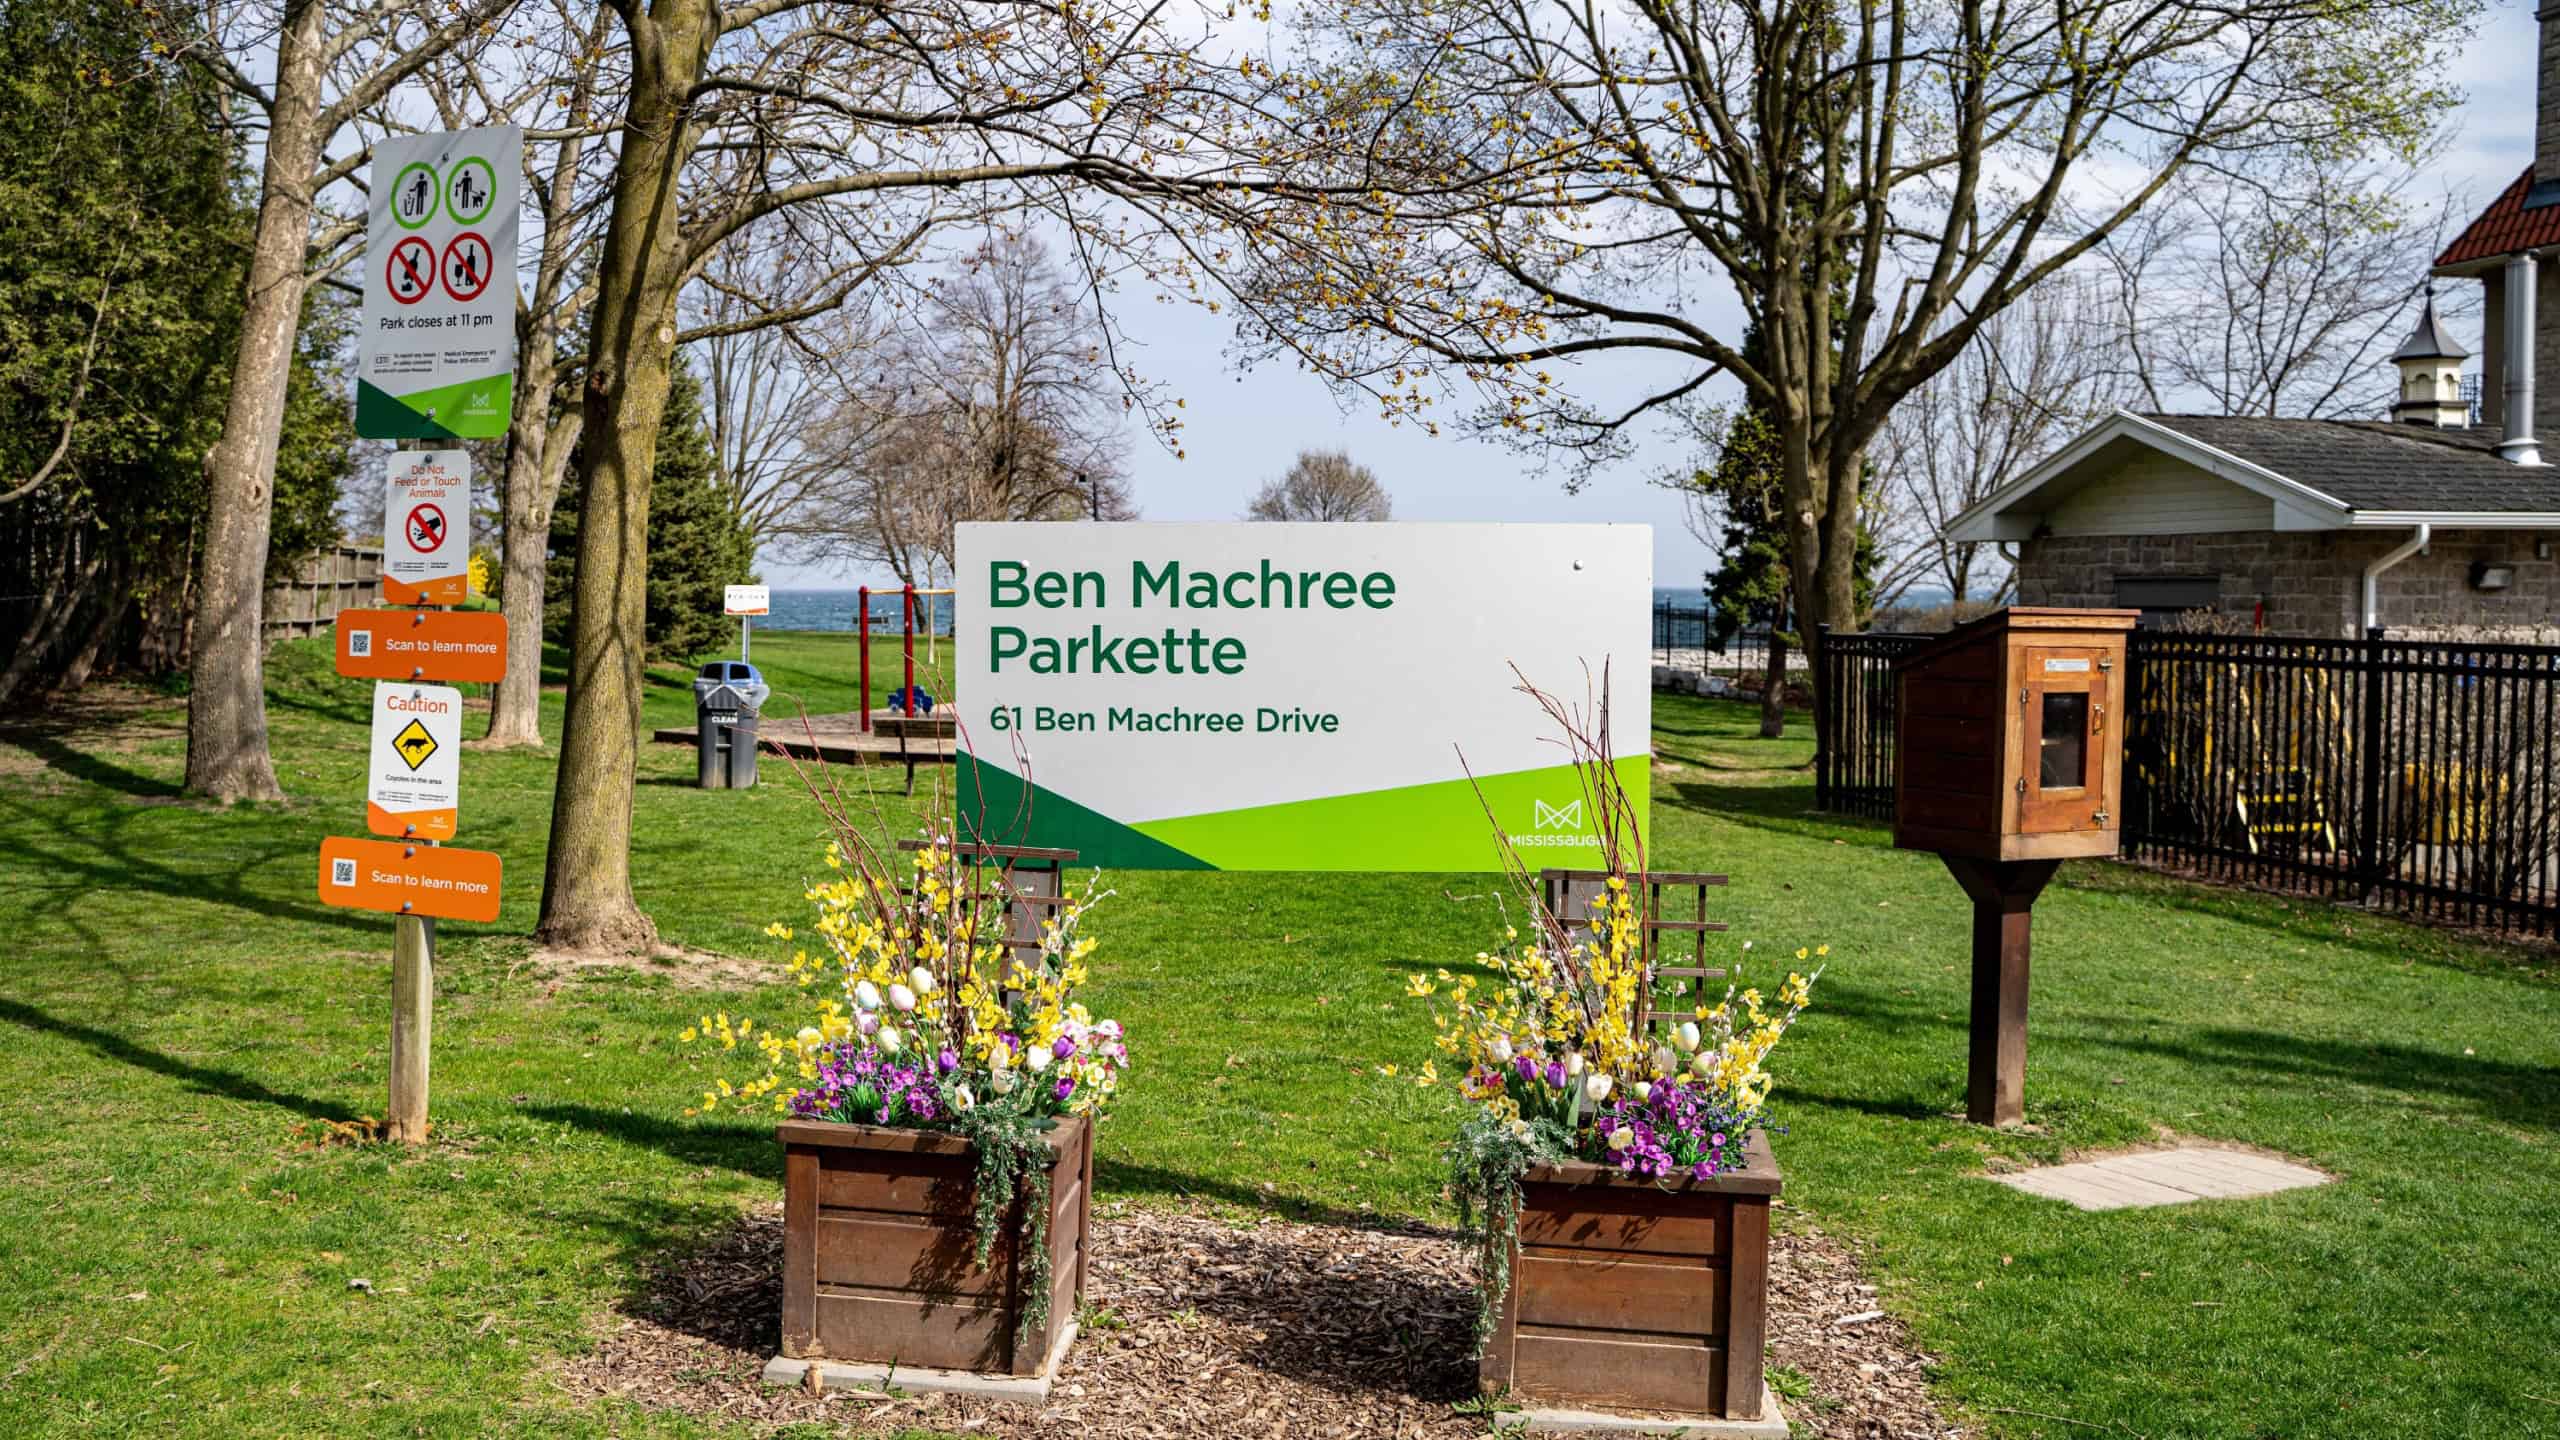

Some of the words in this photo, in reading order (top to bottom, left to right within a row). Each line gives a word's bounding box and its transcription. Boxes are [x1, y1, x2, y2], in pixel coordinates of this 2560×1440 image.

[380, 317, 405, 330] Park
[407, 315, 442, 328] closes
[446, 314, 457, 327] at
[461, 313, 470, 326] 11
[473, 314, 493, 328] pm
[411, 465, 425, 475] Do
[427, 464, 445, 475] Not
[394, 476, 418, 487] Feed
[420, 478, 430, 486] or
[434, 476, 461, 487] Touch
[408, 487, 446, 498] Animals
[991, 560, 1105, 609] Ben
[1133, 560, 1397, 609] Machree
[386, 639, 415, 651] Scan
[417, 640, 430, 652] to
[433, 640, 463, 653] learn
[465, 643, 497, 654] more
[991, 625, 1247, 675] Parkette
[386, 695, 449, 714] Caution
[712, 716, 737, 724] CLEAN
[991, 706, 1022, 732] 61
[1036, 705, 1096, 732] Ben
[1108, 706, 1244, 733] Machree
[1256, 707, 1339, 733] Drive
[371, 869, 401, 884] Scan
[405, 873, 418, 886] to
[421, 874, 453, 889] learn
[455, 881, 489, 893] more
